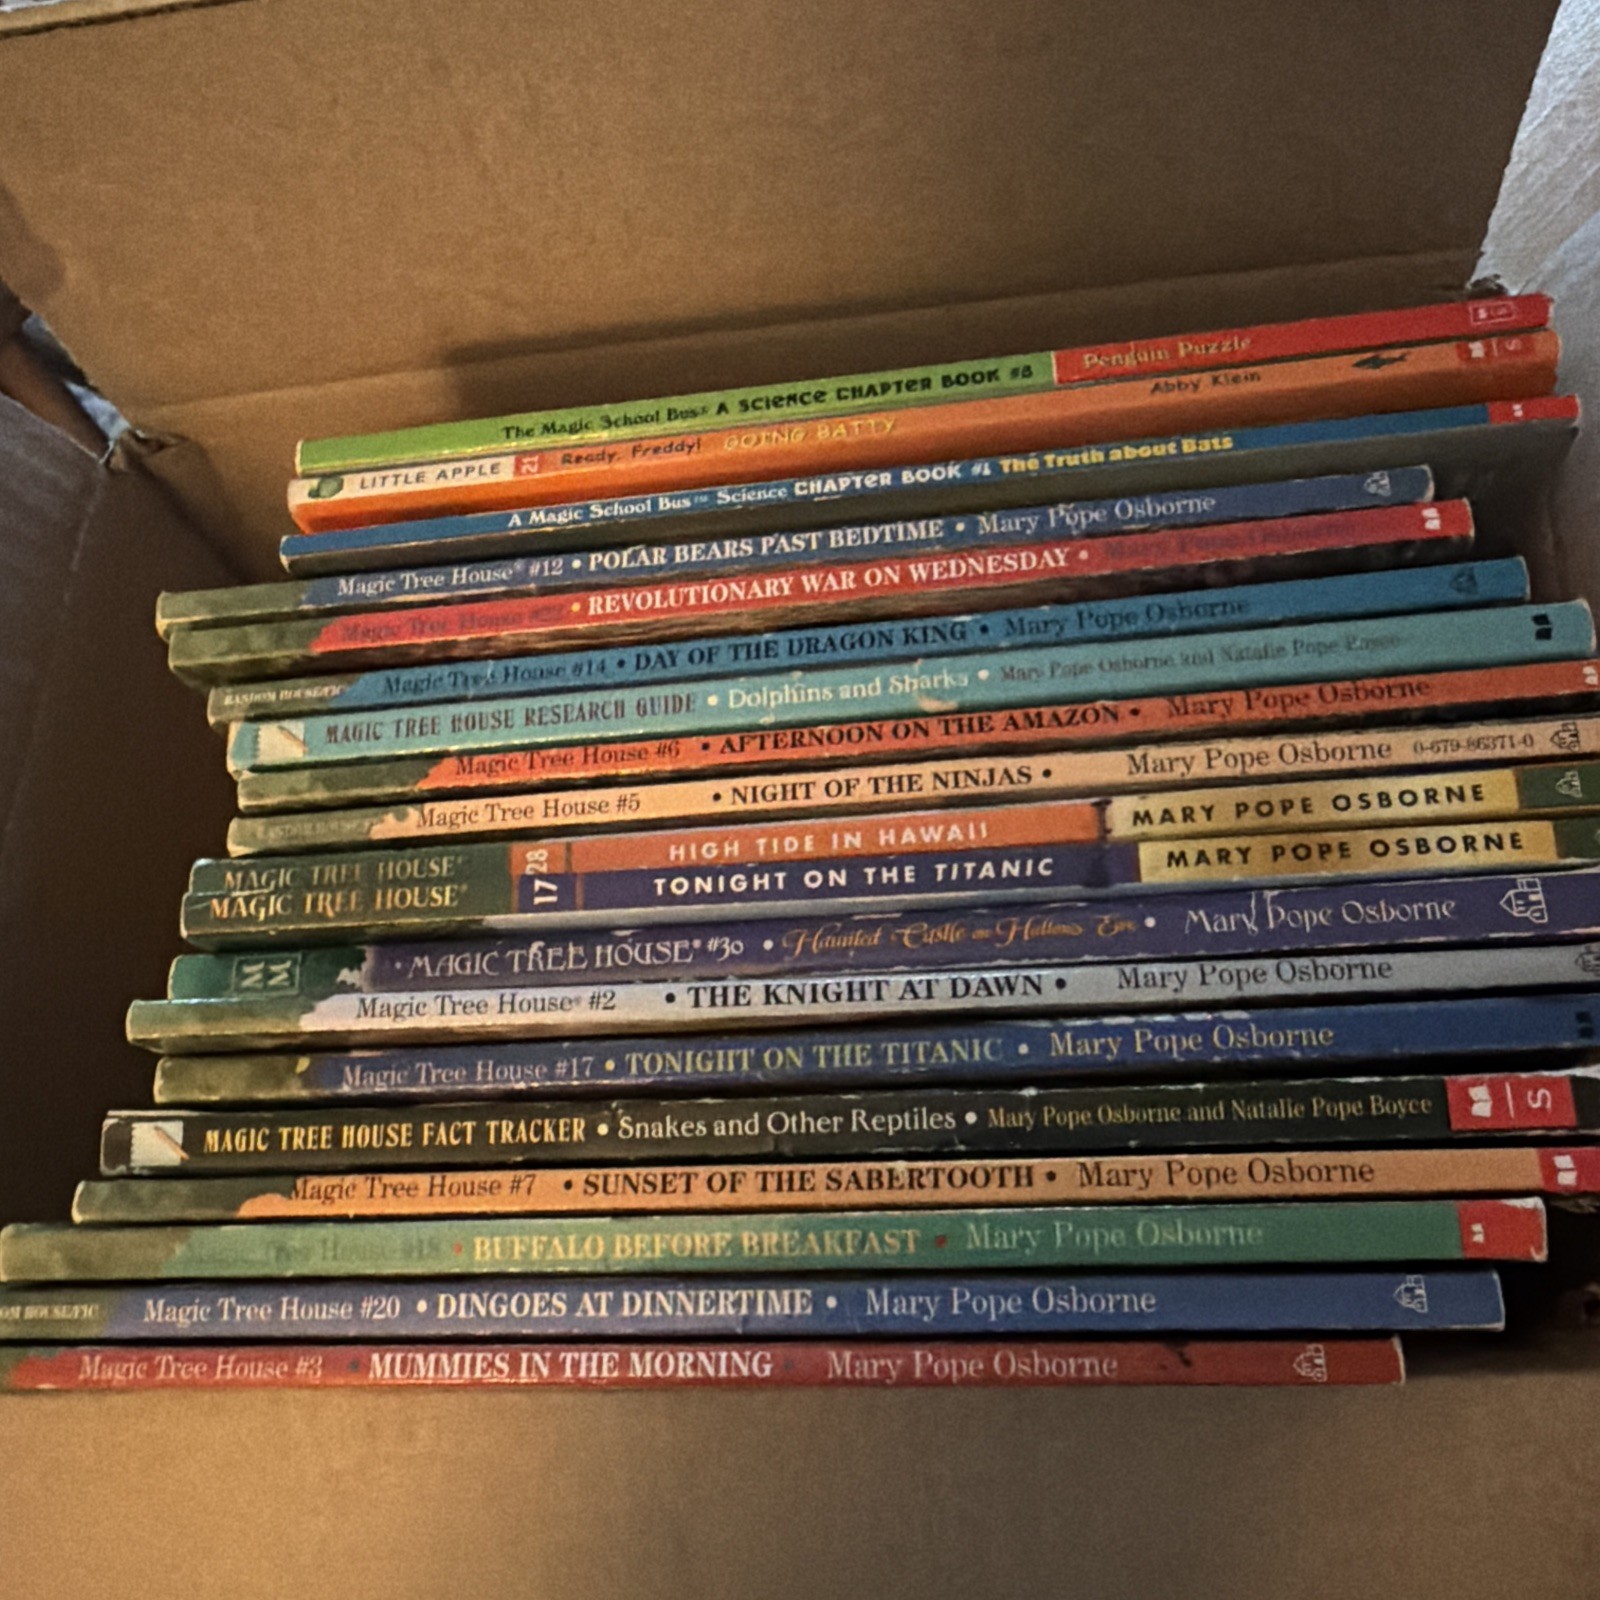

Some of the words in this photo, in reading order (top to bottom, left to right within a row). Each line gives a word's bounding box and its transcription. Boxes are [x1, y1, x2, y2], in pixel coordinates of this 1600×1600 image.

[503, 426, 535, 439] The
[541, 417, 592, 435] Magic
[601, 410, 661, 429] School
[715, 401, 729, 414] A
[941, 369, 999, 388] BOOK
[1083, 348, 1169, 369] Penguin
[1178, 336, 1251, 358] Puzzle
[360, 472, 425, 489] LITTLE
[436, 463, 499, 480] APPLE
[724, 428, 806, 451] GOING
[816, 418, 897, 439] BATTY
[1150, 379, 1200, 395] Abby
[1211, 370, 1260, 386] Klein
[508, 514, 522, 527] A
[529, 508, 582, 527] Magic
[589, 499, 651, 518] School
[717, 486, 788, 504] Science
[901, 465, 961, 484] BOOK
[971, 464, 991, 475] #1
[1000, 456, 1038, 473] The
[1043, 448, 1104, 468] Truth
[1109, 442, 1177, 462] about
[1181, 435, 1233, 454] Bats
[338, 577, 394, 597] Magic
[401, 572, 445, 589] Tree
[528, 559, 563, 577] #12
[588, 547, 665, 571] POLAR
[674, 534, 753, 567] BEARS
[761, 530, 823, 555] PAST
[830, 519, 943, 548] BEDTIME
[979, 514, 1040, 535] Mary
[1048, 501, 1107, 531] Pope
[1114, 495, 1216, 519] Osborne
[588, 576, 793, 615] REVOLUTIONARY
[801, 569, 857, 592] WAR
[864, 564, 900, 586] ON
[908, 547, 1071, 583] WEDNESDAY
[634, 651, 680, 671] DAY
[688, 646, 720, 664] OF
[728, 640, 779, 661] THE
[787, 628, 894, 655] DRAGON
[902, 623, 968, 645] KING
[326, 722, 383, 743] MAGIC
[395, 716, 441, 737] TREE
[451, 710, 515, 733] HOUSE
[524, 696, 626, 727] RESEARCH
[636, 692, 694, 717] GUIDE
[729, 683, 832, 708] Dolphins
[840, 675, 881, 698] and
[889, 668, 969, 695] Sharks
[720, 723, 884, 754] AFTERNOON
[892, 721, 930, 739] ON
[939, 714, 994, 736] THE
[1002, 704, 1120, 731] AMAZON
[417, 807, 479, 830] Magic
[485, 803, 534, 822] Tree
[543, 797, 610, 818] House
[616, 792, 640, 812] #5
[731, 781, 816, 805] NIGHT
[825, 777, 860, 797] OF
[868, 773, 923, 793] THE
[933, 766, 1033, 791] NINJAS
[1127, 753, 1195, 777] Mary
[1205, 747, 1270, 775] Pope
[1278, 741, 1392, 765] Osborne
[669, 841, 740, 861] HIGH
[757, 834, 815, 854] TIDE
[832, 831, 862, 849] IN
[879, 821, 989, 847] HAWAII
[1133, 805, 1214, 826] MARY
[1235, 797, 1314, 819] POPE
[1332, 784, 1484, 812] OSBORNE
[210, 894, 292, 921] MAGIC
[304, 891, 363, 917] TREE
[533, 879, 558, 905] 17
[654, 872, 788, 895] TONIGHT
[803, 869, 847, 888] ON
[864, 866, 916, 884] THE
[935, 858, 1054, 881] TITANIC
[1167, 848, 1251, 868] MARY
[1272, 842, 1351, 862] POPE
[1370, 832, 1524, 857] OSBORNE
[408, 953, 499, 979] MAGIC
[506, 941, 588, 973] TREE
[707, 937, 744, 961] #30
[688, 985, 752, 1009] THE
[764, 980, 890, 1005] KNIGHT
[899, 977, 936, 1000] AT
[950, 974, 1043, 999] DAWN
[625, 1047, 755, 1075] TONIGHT
[764, 1047, 801, 1069] ON
[812, 1044, 871, 1066] THE
[883, 1038, 1003, 1066] TITANIC
[204, 1128, 270, 1152] MAGIC
[279, 1125, 333, 1150] TREE
[341, 1122, 412, 1148] HOUSE
[423, 1121, 476, 1146] FACT
[486, 1118, 586, 1145] TRACKER
[618, 1116, 707, 1139] Snakes
[714, 1112, 759, 1136] and
[766, 1111, 843, 1134] Other
[851, 1106, 956, 1135] Reptiles
[988, 1107, 1036, 1128] Mary
[1044, 1105, 1092, 1128] Pope
[1098, 1102, 1182, 1124] Osborne
[1187, 1100, 1225, 1121] and
[1232, 1097, 1305, 1120] Natalie
[1312, 1096, 1366, 1119] Pope
[1370, 1096, 1432, 1117] Boyce
[583, 1172, 700, 1195] SUNSET
[707, 1172, 748, 1193] OF
[756, 1170, 815, 1192] THE
[825, 1165, 1034, 1192] SABERTOOTH
[473, 1236, 604, 1262] BUFFALO
[613, 1233, 732, 1258] BEFORE
[741, 1228, 922, 1258] BREAKFAST
[967, 1223, 1041, 1253] Mary
[1055, 1221, 1127, 1251] Pope
[1136, 1218, 1264, 1247] Osborne
[144, 1300, 208, 1327] Magic
[217, 1298, 273, 1321] Tree
[280, 1297, 352, 1320] House
[360, 1296, 400, 1320] #20
[437, 1291, 567, 1319] DINGOES
[575, 1290, 614, 1316] AT
[622, 1289, 813, 1316] DINNERTIME
[79, 1355, 148, 1382] Magic
[155, 1354, 208, 1379] Tree
[216, 1355, 288, 1379] House
[297, 1355, 323, 1378] #3
[368, 1351, 509, 1379] MUMMIES
[519, 1353, 552, 1378] IN
[559, 1352, 621, 1377] THE
[629, 1351, 772, 1377] MORNING
[827, 1350, 900, 1381] Mary
[914, 1350, 985, 1380] Pope
[993, 1348, 1118, 1378] Osborne
